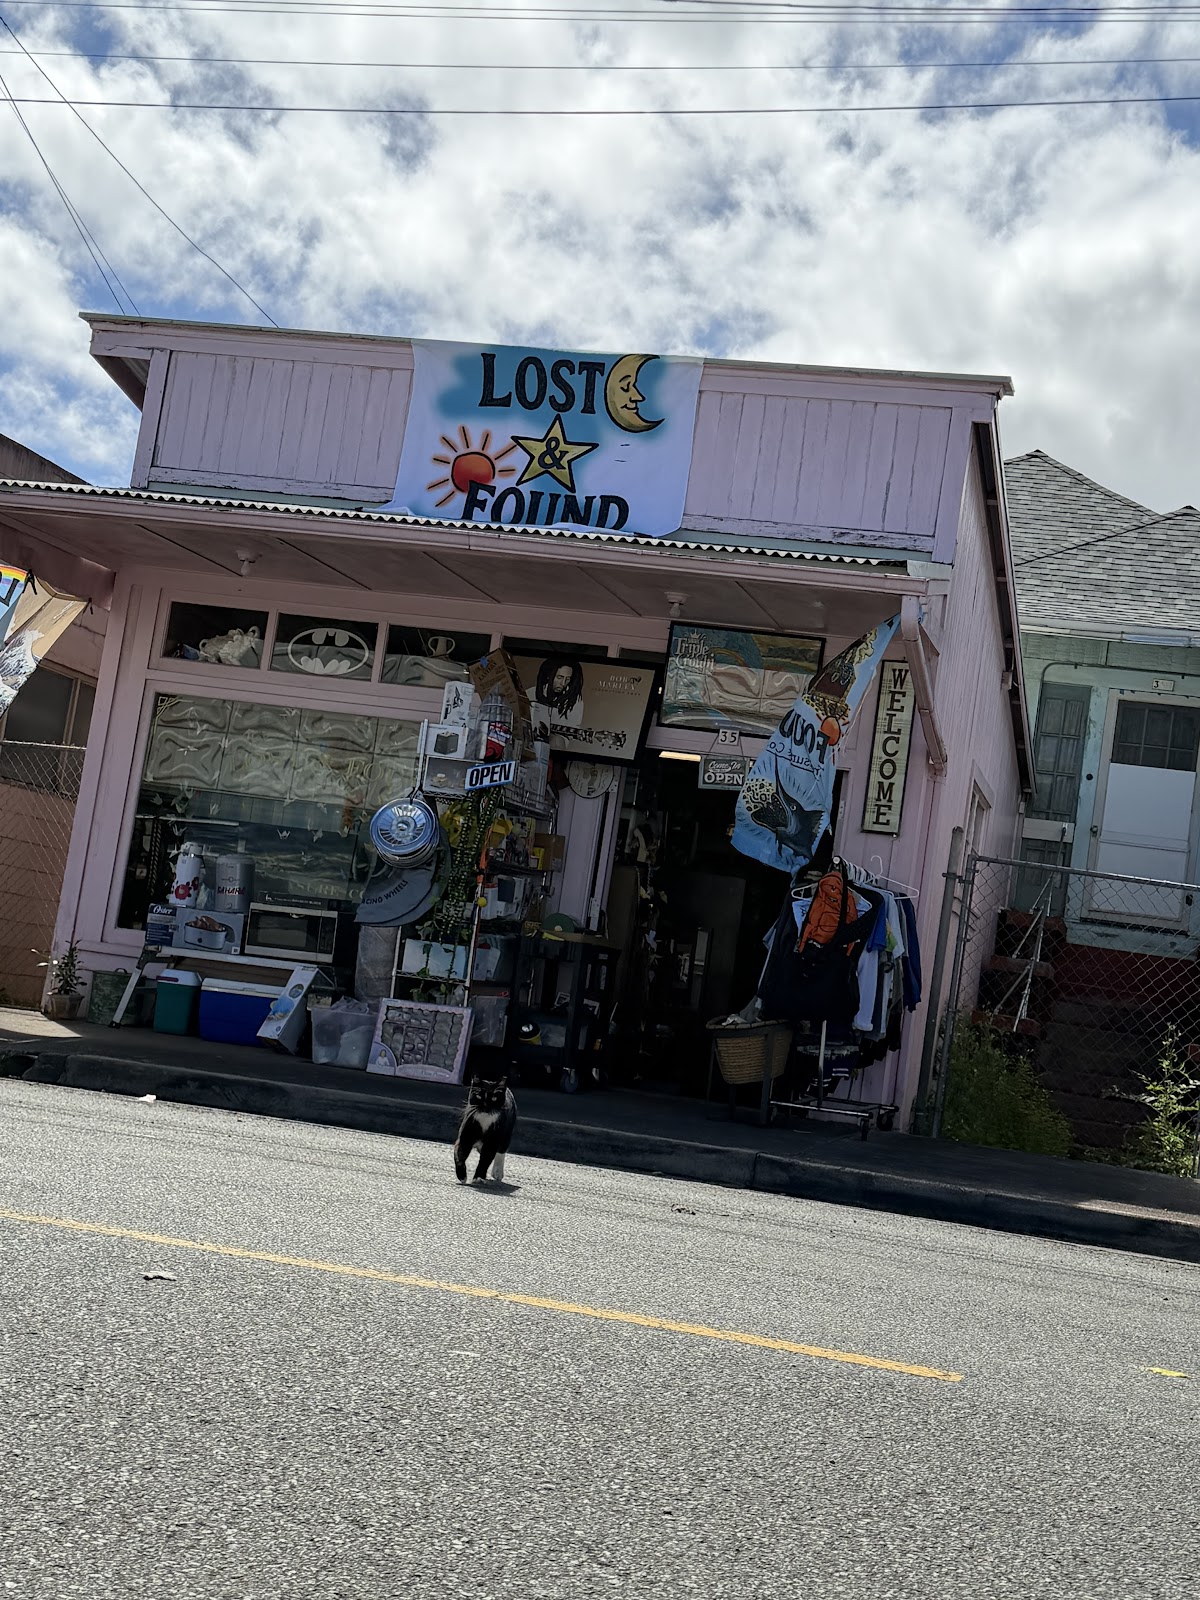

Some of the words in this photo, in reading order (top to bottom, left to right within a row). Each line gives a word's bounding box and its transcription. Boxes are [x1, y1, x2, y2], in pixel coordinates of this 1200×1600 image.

[478, 352, 606, 415] LOST
[537, 436, 570, 471] &
[461, 481, 629, 530] FOUND
[673, 636, 709, 660] Triple
[719, 730, 739, 744] 35
[872, 667, 912, 827] WELCOME
[469, 763, 513, 786] OPEN
[708, 760, 732, 772] Come
[730, 760, 742, 771] In
[703, 772, 745, 786] OPEN
[388, 879, 414, 900] WHEELS
[152, 904, 174, 915] Oster
